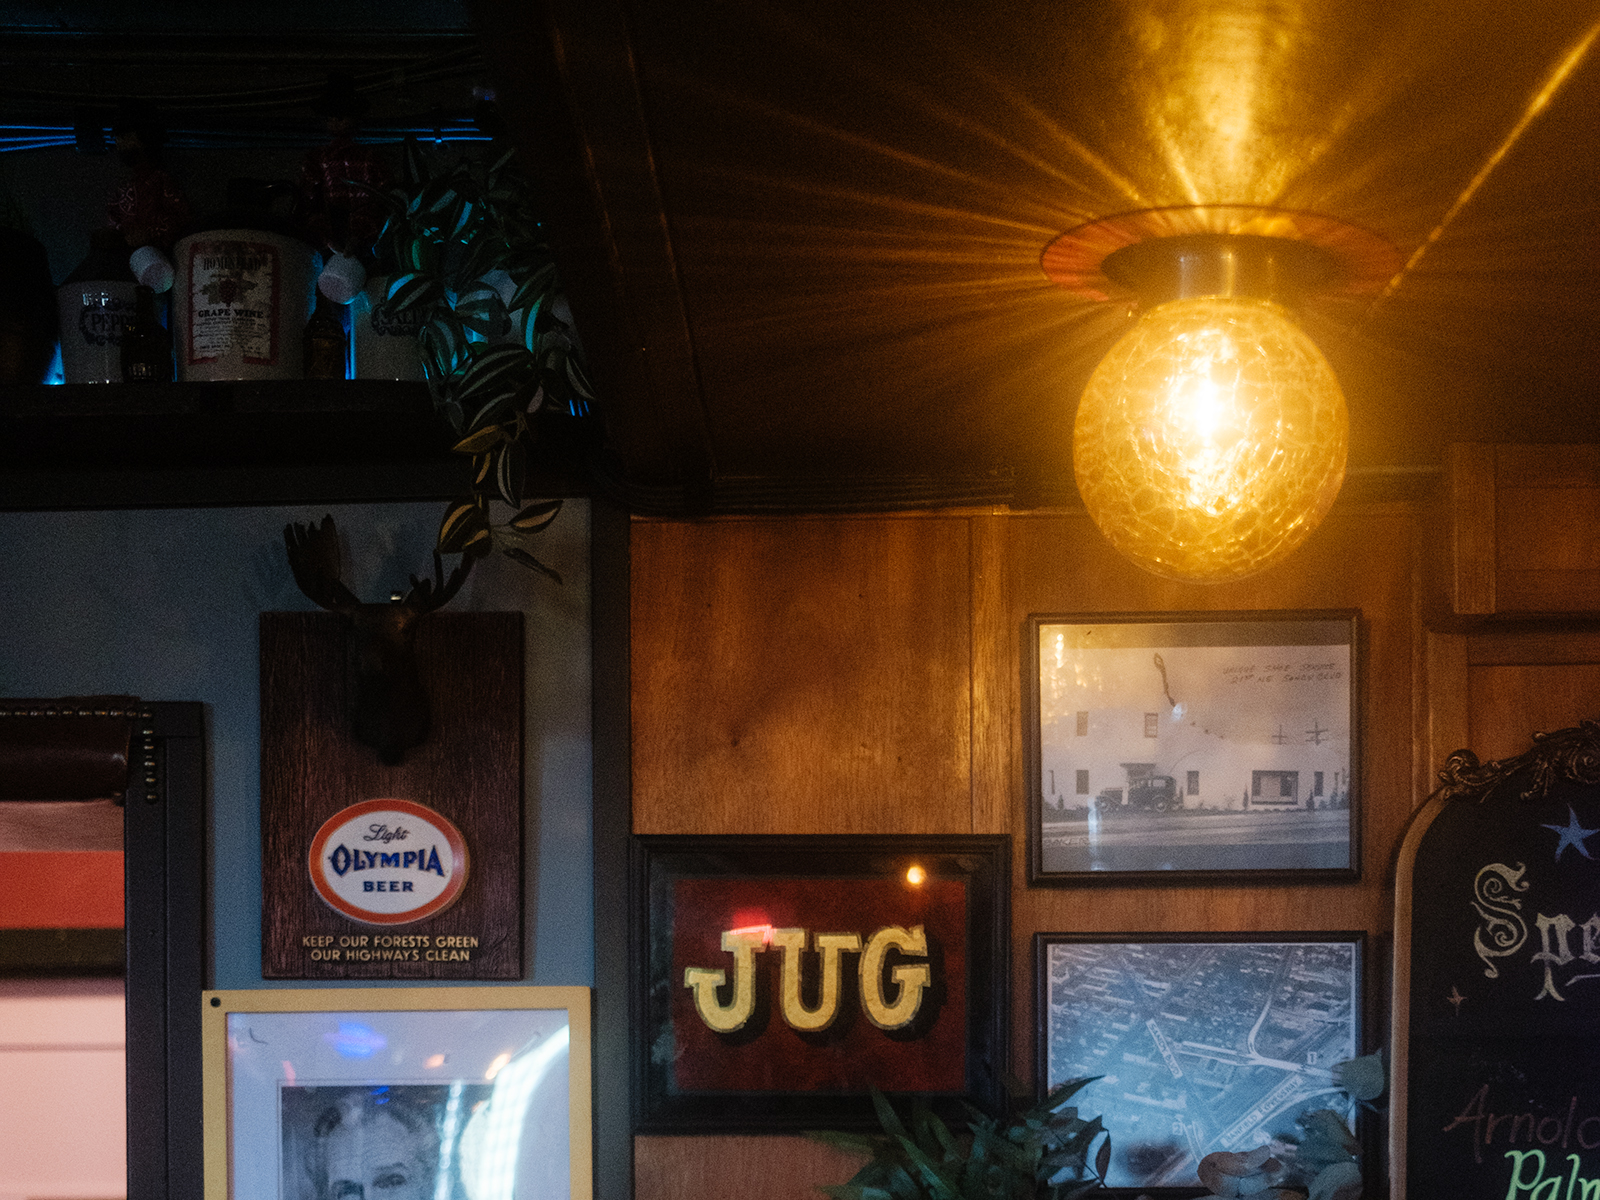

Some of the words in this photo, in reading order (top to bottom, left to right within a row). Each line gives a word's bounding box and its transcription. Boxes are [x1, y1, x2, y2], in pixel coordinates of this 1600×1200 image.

[198, 308, 231, 317] GRAPE
[234, 309, 264, 318] WINE
[363, 823, 410, 844] Light
[328, 843, 446, 878] OLYMPIA
[362, 881, 414, 892] BEER
[302, 935, 334, 948] KEEP
[339, 935, 369, 948] OUR
[374, 935, 430, 948] FORESTS
[435, 935, 479, 948] GREEN
[310, 950, 341, 962] OUR
[345, 950, 420, 962] HIGHWAYS
[425, 950, 470, 962] CLEAN
[684, 924, 932, 1034] JUG
